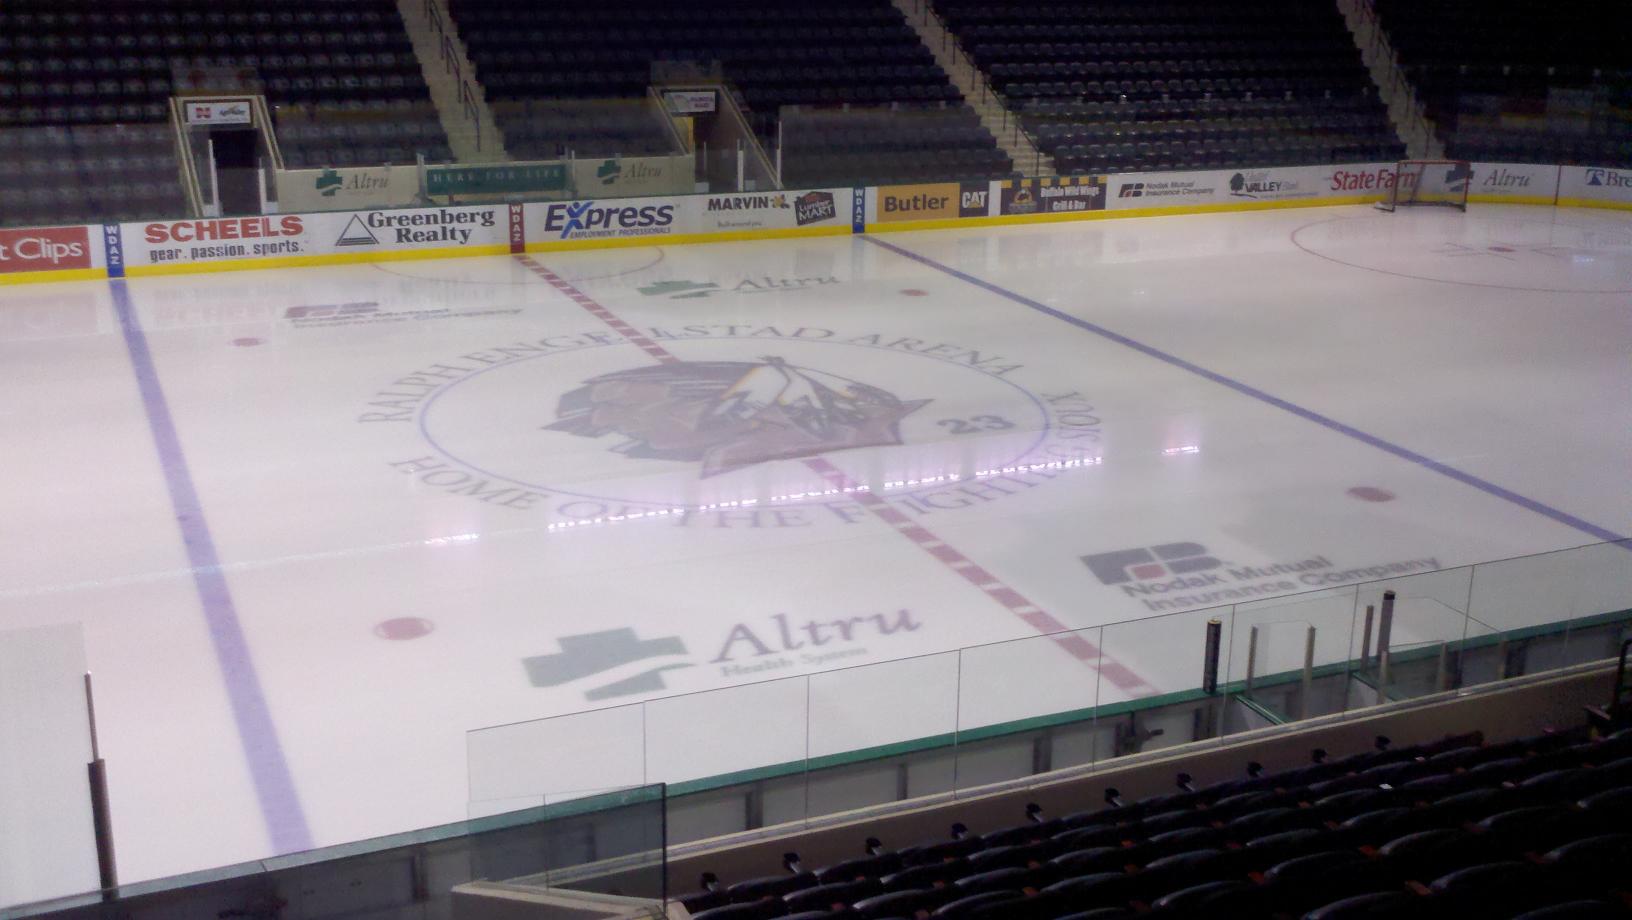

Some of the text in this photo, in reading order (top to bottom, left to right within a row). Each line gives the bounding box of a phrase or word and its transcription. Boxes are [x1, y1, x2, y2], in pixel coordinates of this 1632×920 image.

[624, 160, 663, 178] Altru
[1483, 168, 1530, 187] Altru
[346, 173, 390, 190] Altru
[1245, 182, 1282, 193] VALLEY
[961, 191, 988, 209] CAT
[1040, 185, 1099, 198] Buffalo Wild Wings
[1145, 187, 1216, 197] Insurance Company
[708, 196, 769, 211] MARVIN
[884, 193, 949, 213] Butler
[367, 209, 495, 228] Greenberg
[799, 205, 832, 221] MART
[145, 215, 304, 244] SCHEELS
[510, 205, 522, 242] WDAZ
[570, 227, 671, 239] EMPLOYMENT PROFESSIONALS
[395, 226, 471, 244] Realty
[14, 237, 84, 265] Clips
[106, 225, 120, 266] WDAZ
[357, 362, 462, 423] RALPH
[847, 332, 1025, 378] ARENA
[937, 415, 1017, 434] 23
[388, 455, 552, 510] HOME
[1120, 554, 1335, 599] Nodak Mutual
[1139, 555, 1444, 613] Insurance Company
[709, 609, 922, 664] Altru
[719, 646, 868, 678] Health System
